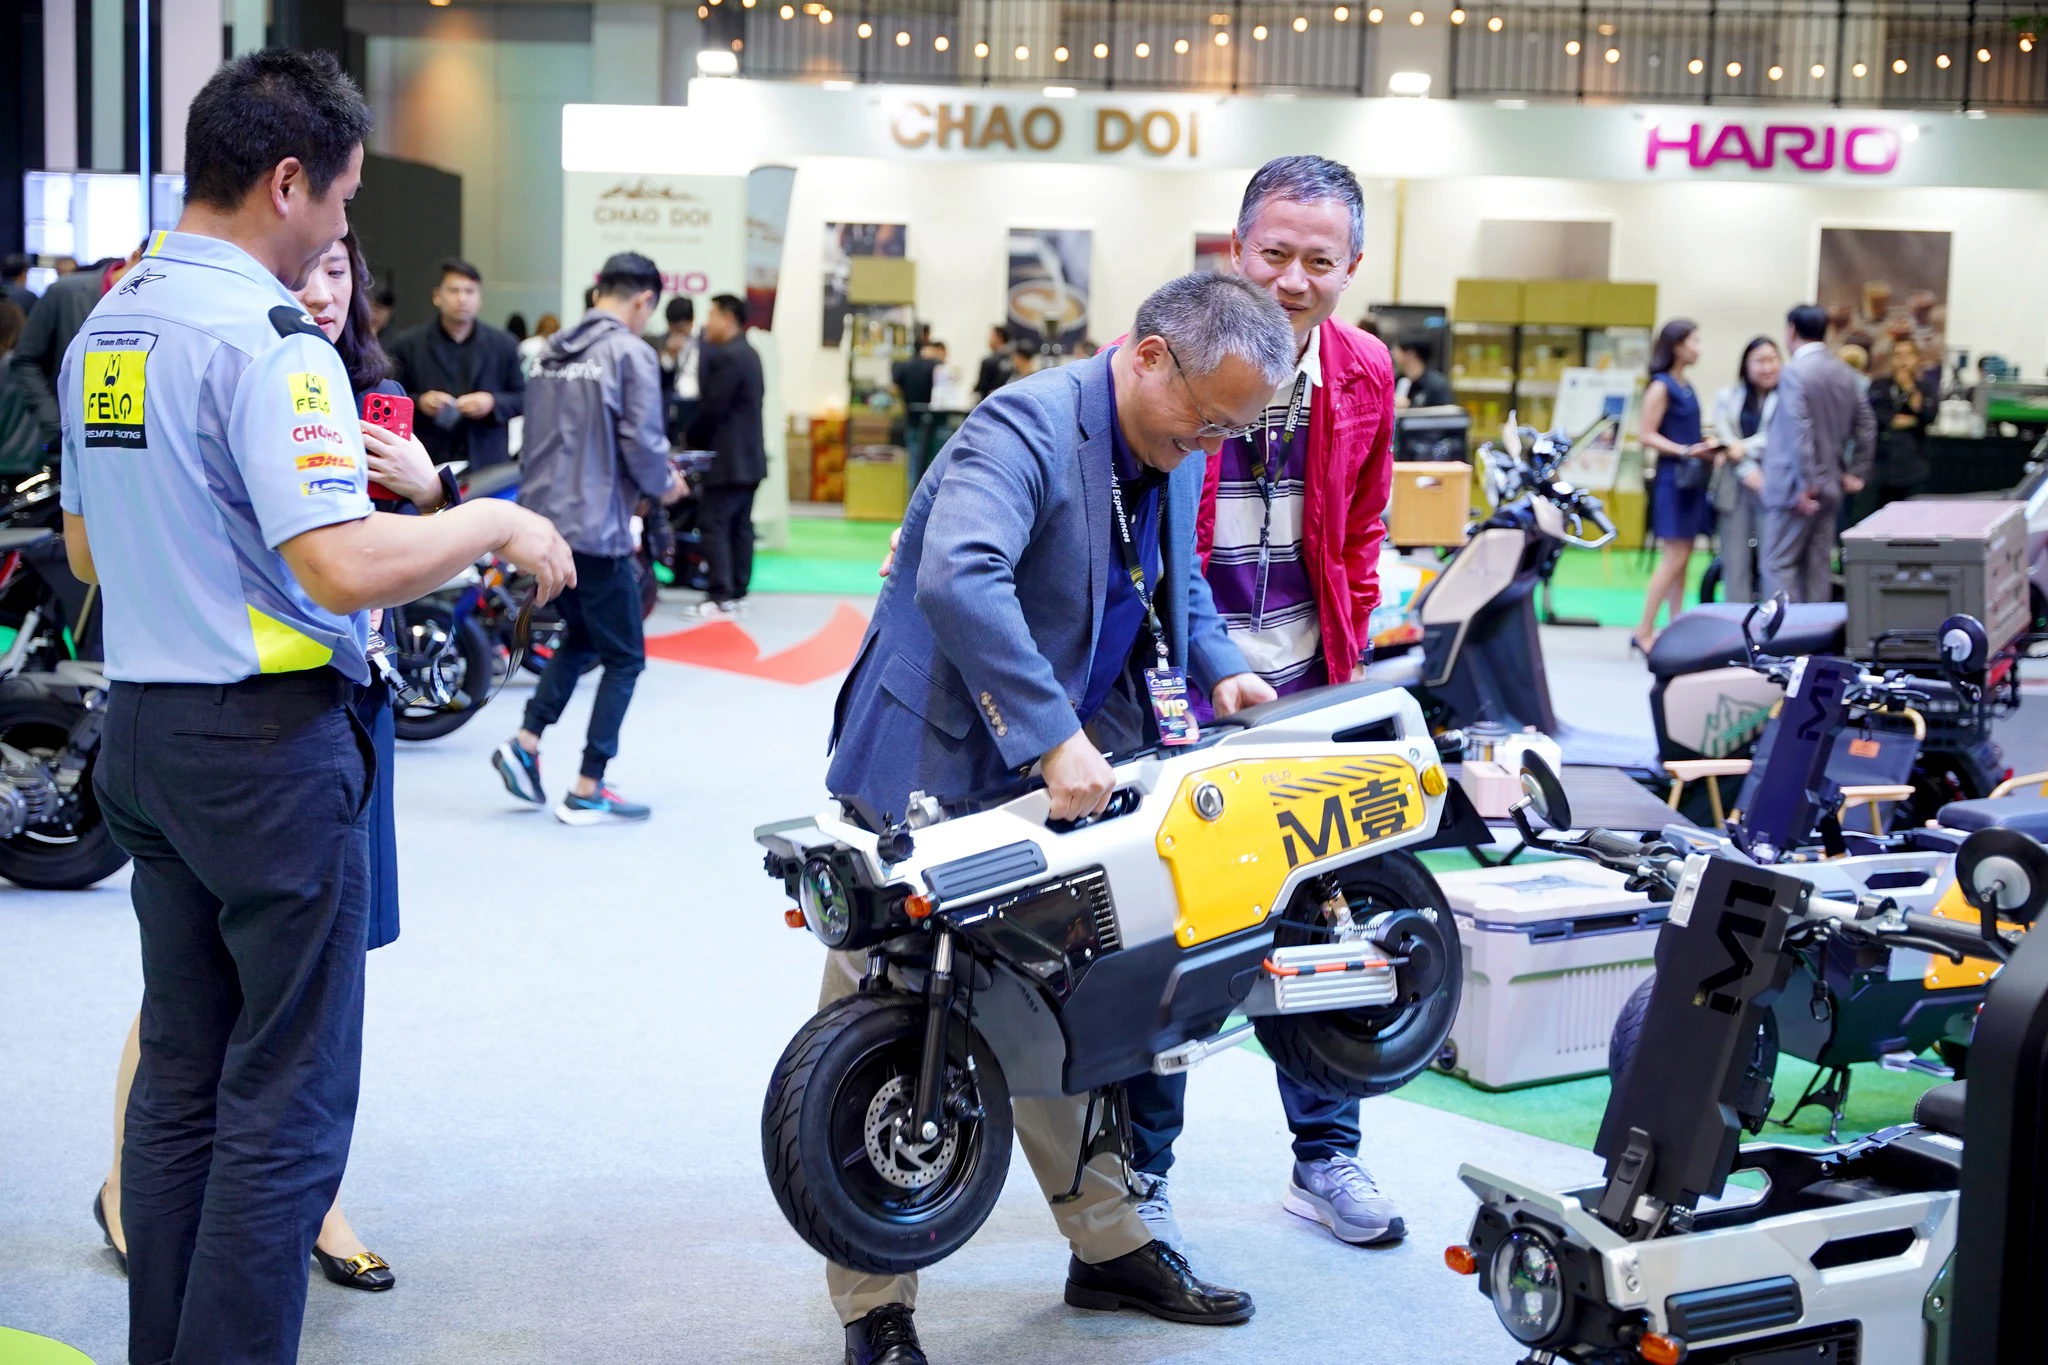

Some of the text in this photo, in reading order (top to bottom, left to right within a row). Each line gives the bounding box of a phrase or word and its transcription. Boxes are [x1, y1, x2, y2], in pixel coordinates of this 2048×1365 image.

[891, 101, 1199, 158] CHAO DOI
[1646, 123, 1898, 175] HARIO
[96, 338, 115, 346] Team
[87, 392, 132, 420] FELO
[296, 396, 330, 413] FELO
[1289, 396, 1303, 432] MOTOR
[306, 455, 346, 468] DHL
[1111, 489, 1131, 543] Experiences
[1157, 698, 1189, 718] VIP
